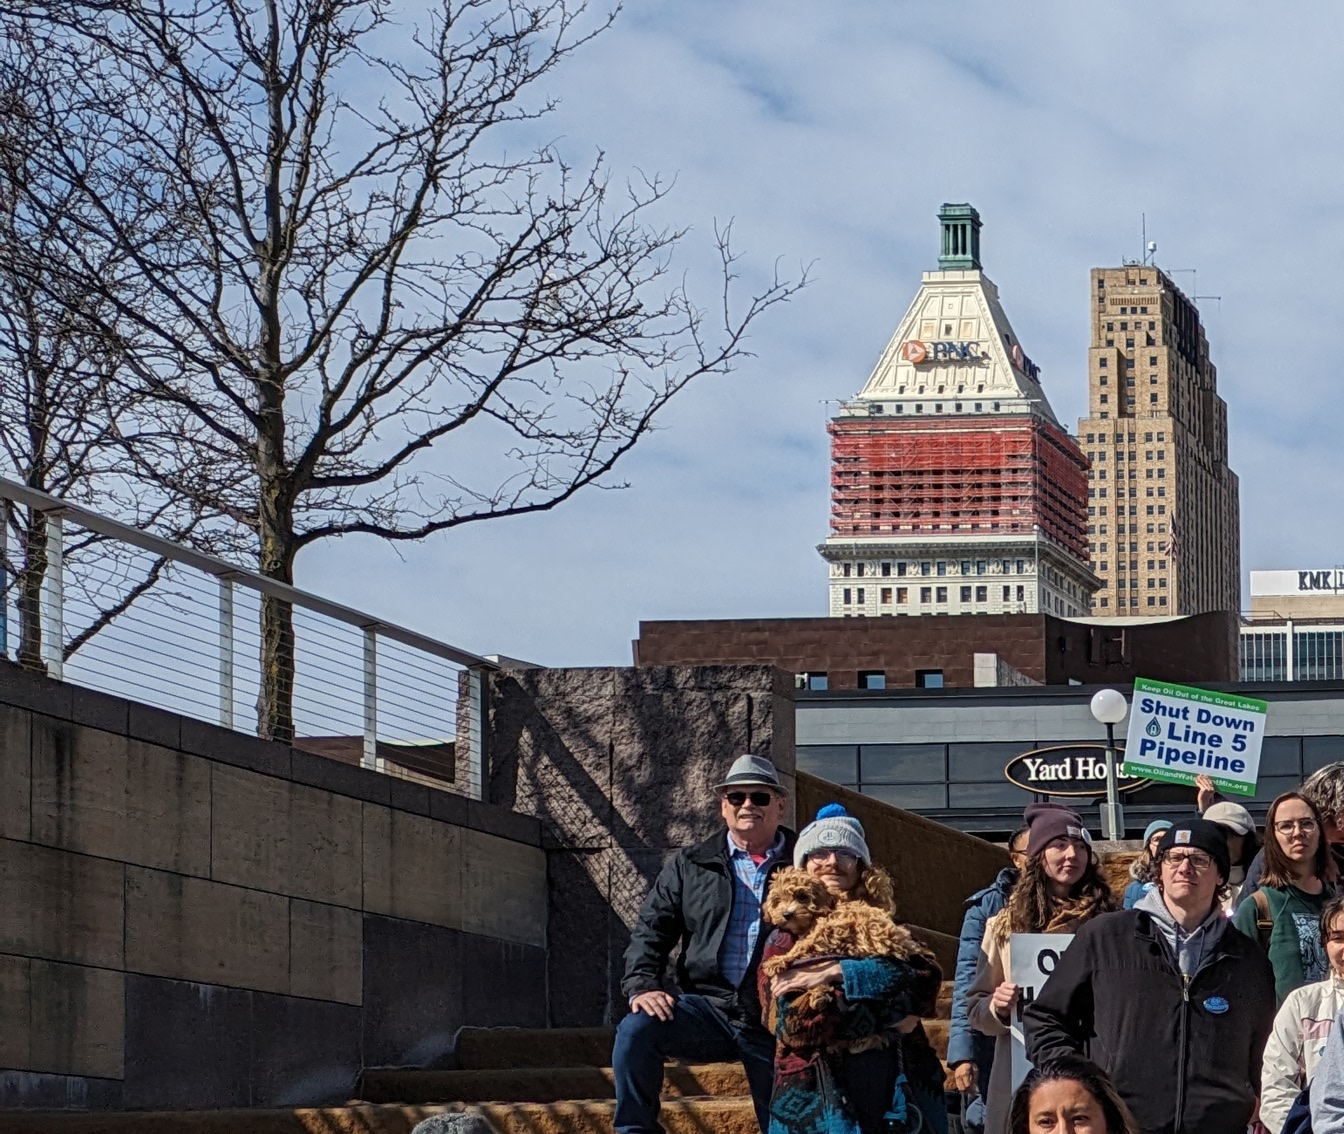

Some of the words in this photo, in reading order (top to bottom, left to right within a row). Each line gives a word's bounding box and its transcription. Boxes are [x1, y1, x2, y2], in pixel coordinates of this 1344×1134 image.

[933, 342, 981, 360] PNC
[1298, 571, 1332, 590] KMK
[1141, 684, 1161, 694] Keep
[1162, 688, 1174, 696] Oil
[1175, 691, 1189, 699] Out
[1200, 695, 1214, 703] the
[1215, 698, 1236, 707] Great
[1237, 702, 1260, 712] Lakes
[1140, 698, 1190, 721] Shut
[1196, 708, 1255, 733] Down
[1167, 722, 1223, 748] Line
[1231, 734, 1247, 752] 5
[1022, 757, 1072, 781] Yard
[1139, 738, 1246, 773] Pipeline
